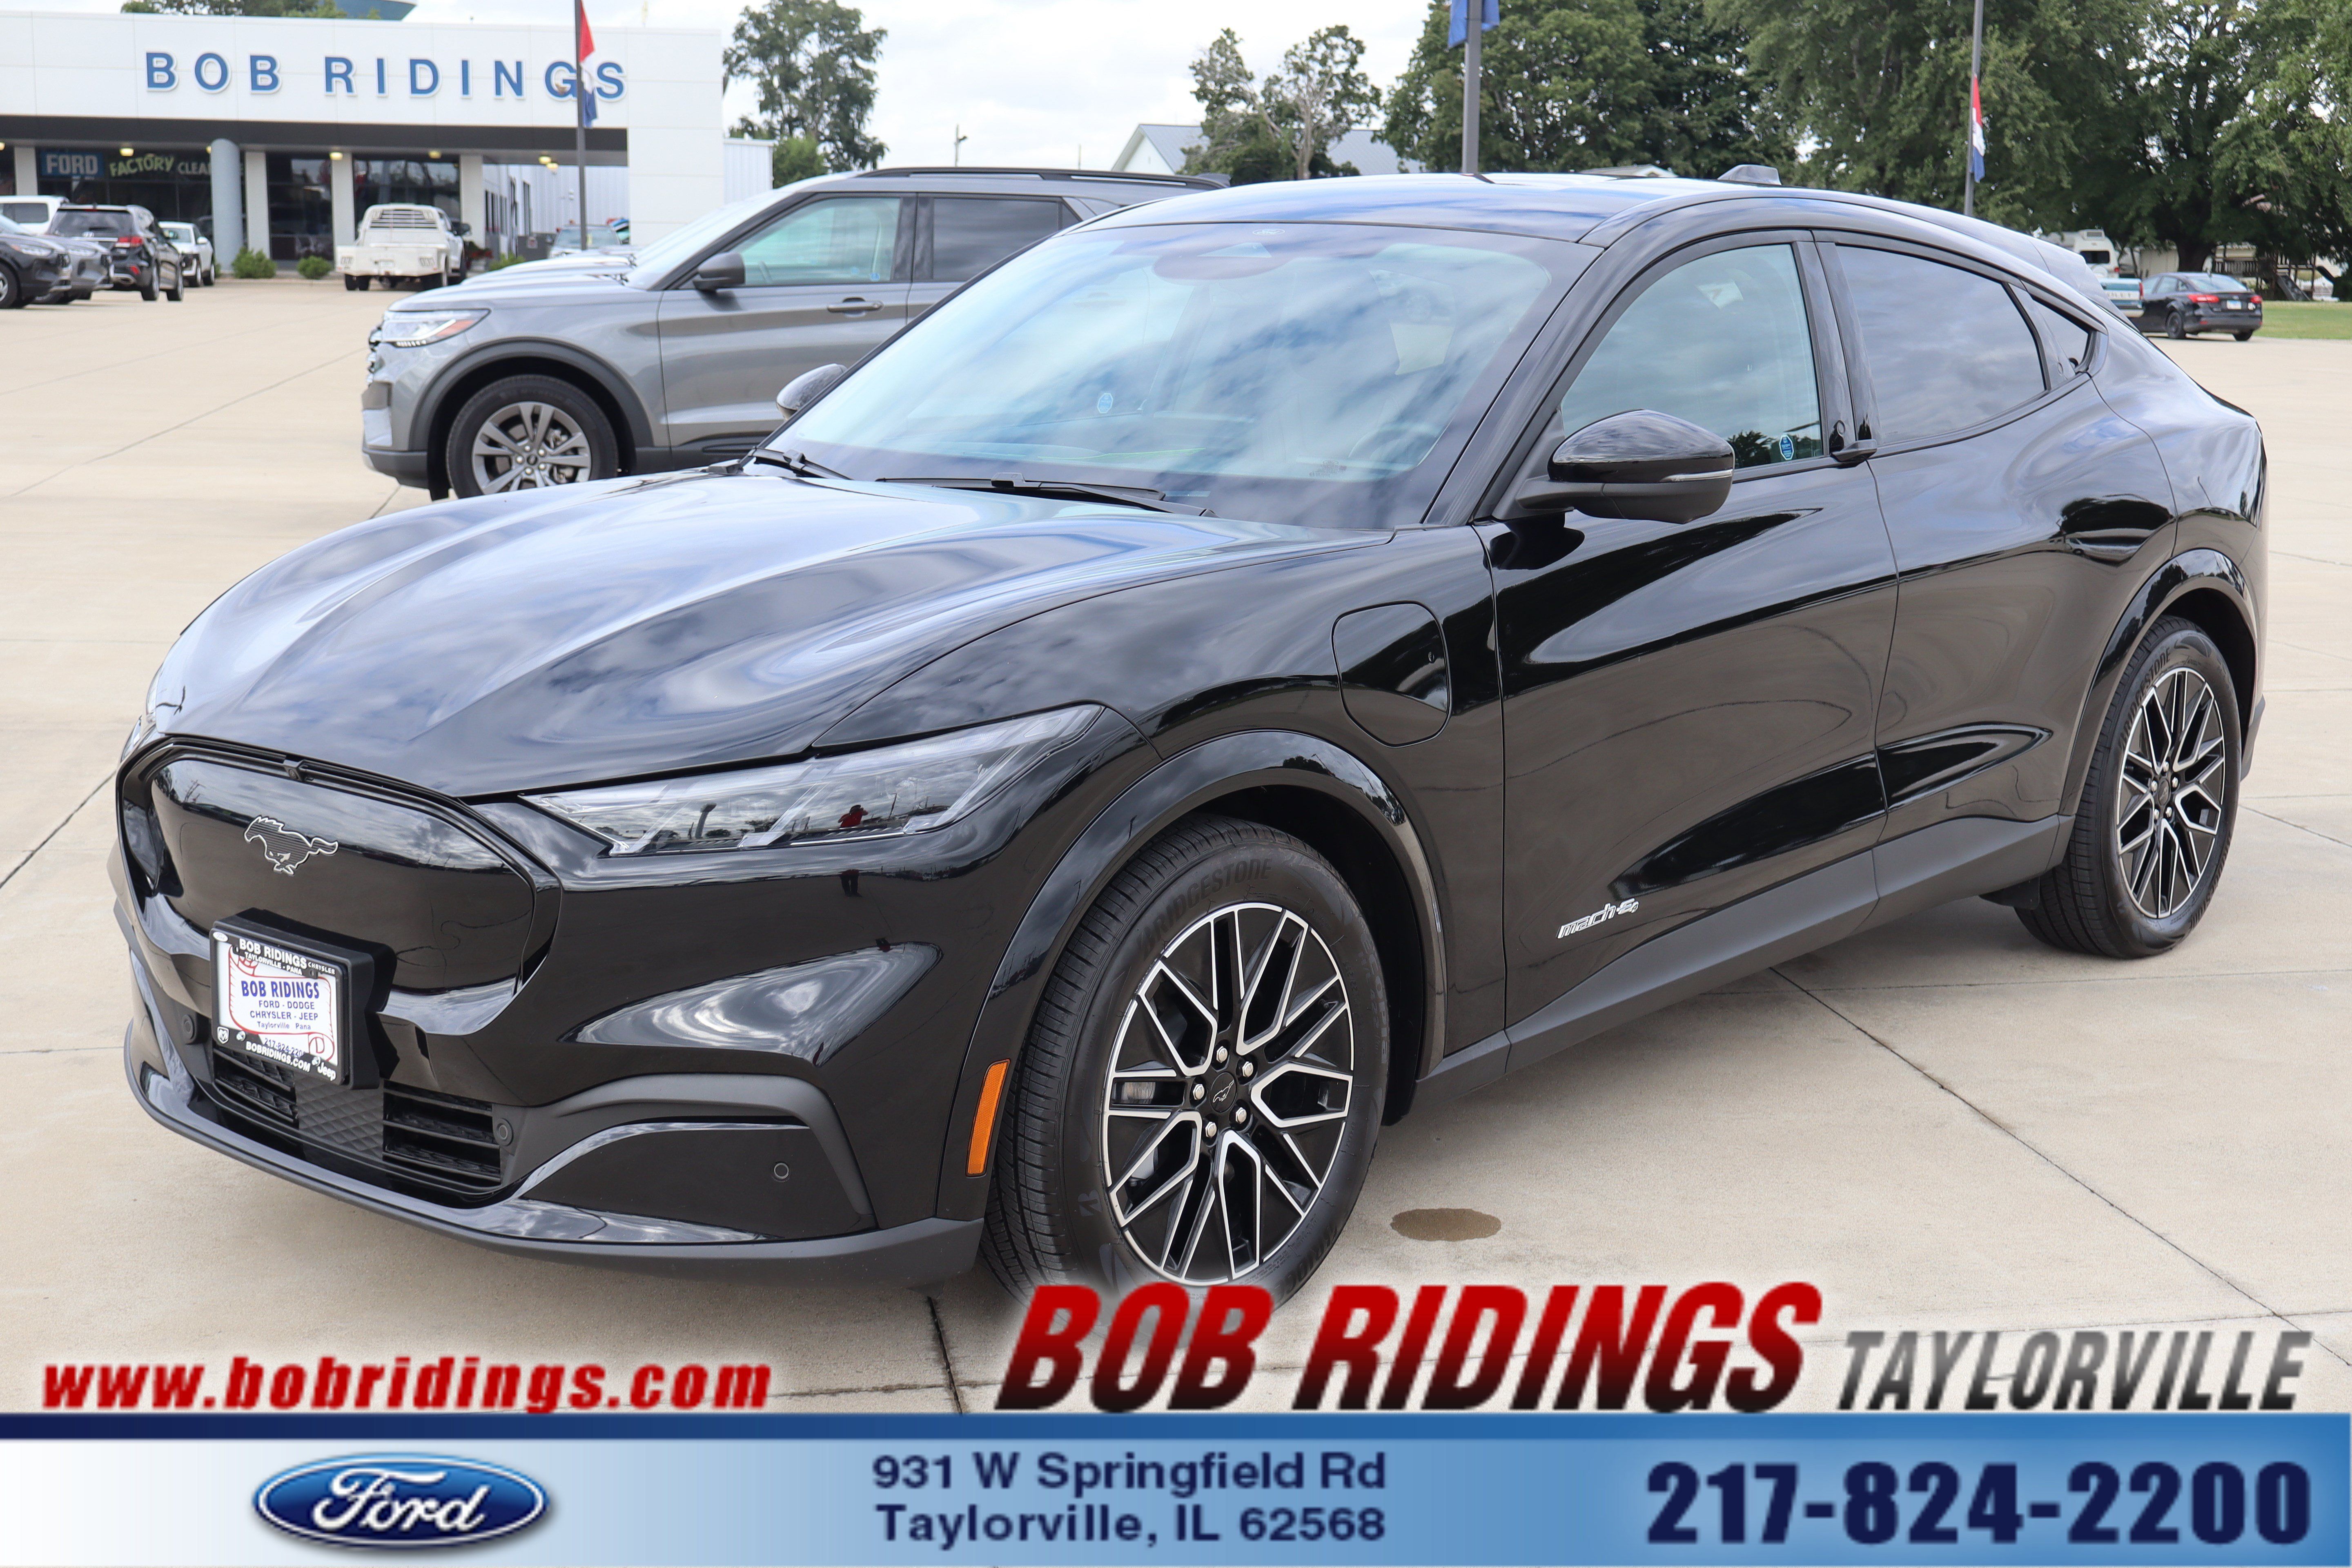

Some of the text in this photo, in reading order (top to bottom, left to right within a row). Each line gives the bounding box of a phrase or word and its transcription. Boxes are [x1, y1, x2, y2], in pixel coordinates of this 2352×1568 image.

[146, 52, 626, 100] BOB RIDINGS
[46, 153, 98, 175] FORD
[110, 156, 174, 177] FACTORY
[1138, 858, 1272, 956] BRIDGESTONE
[239, 938, 307, 969] BOB RIDINGS
[245, 951, 282, 969] TAYLORVILLE
[286, 965, 303, 975] PANA
[307, 962, 335, 975] CHRYSLER
[241, 980, 320, 999] BOB RIDINGS
[250, 1011, 292, 1019] CHRYSLER
[299, 1012, 318, 1020] JEEP
[287, 1001, 315, 1009] DODGE
[257, 1021, 290, 1029] Taylorville
[246, 1041, 311, 1072] BOBRIDINGS.COM
[317, 1062, 336, 1081] Jeep
